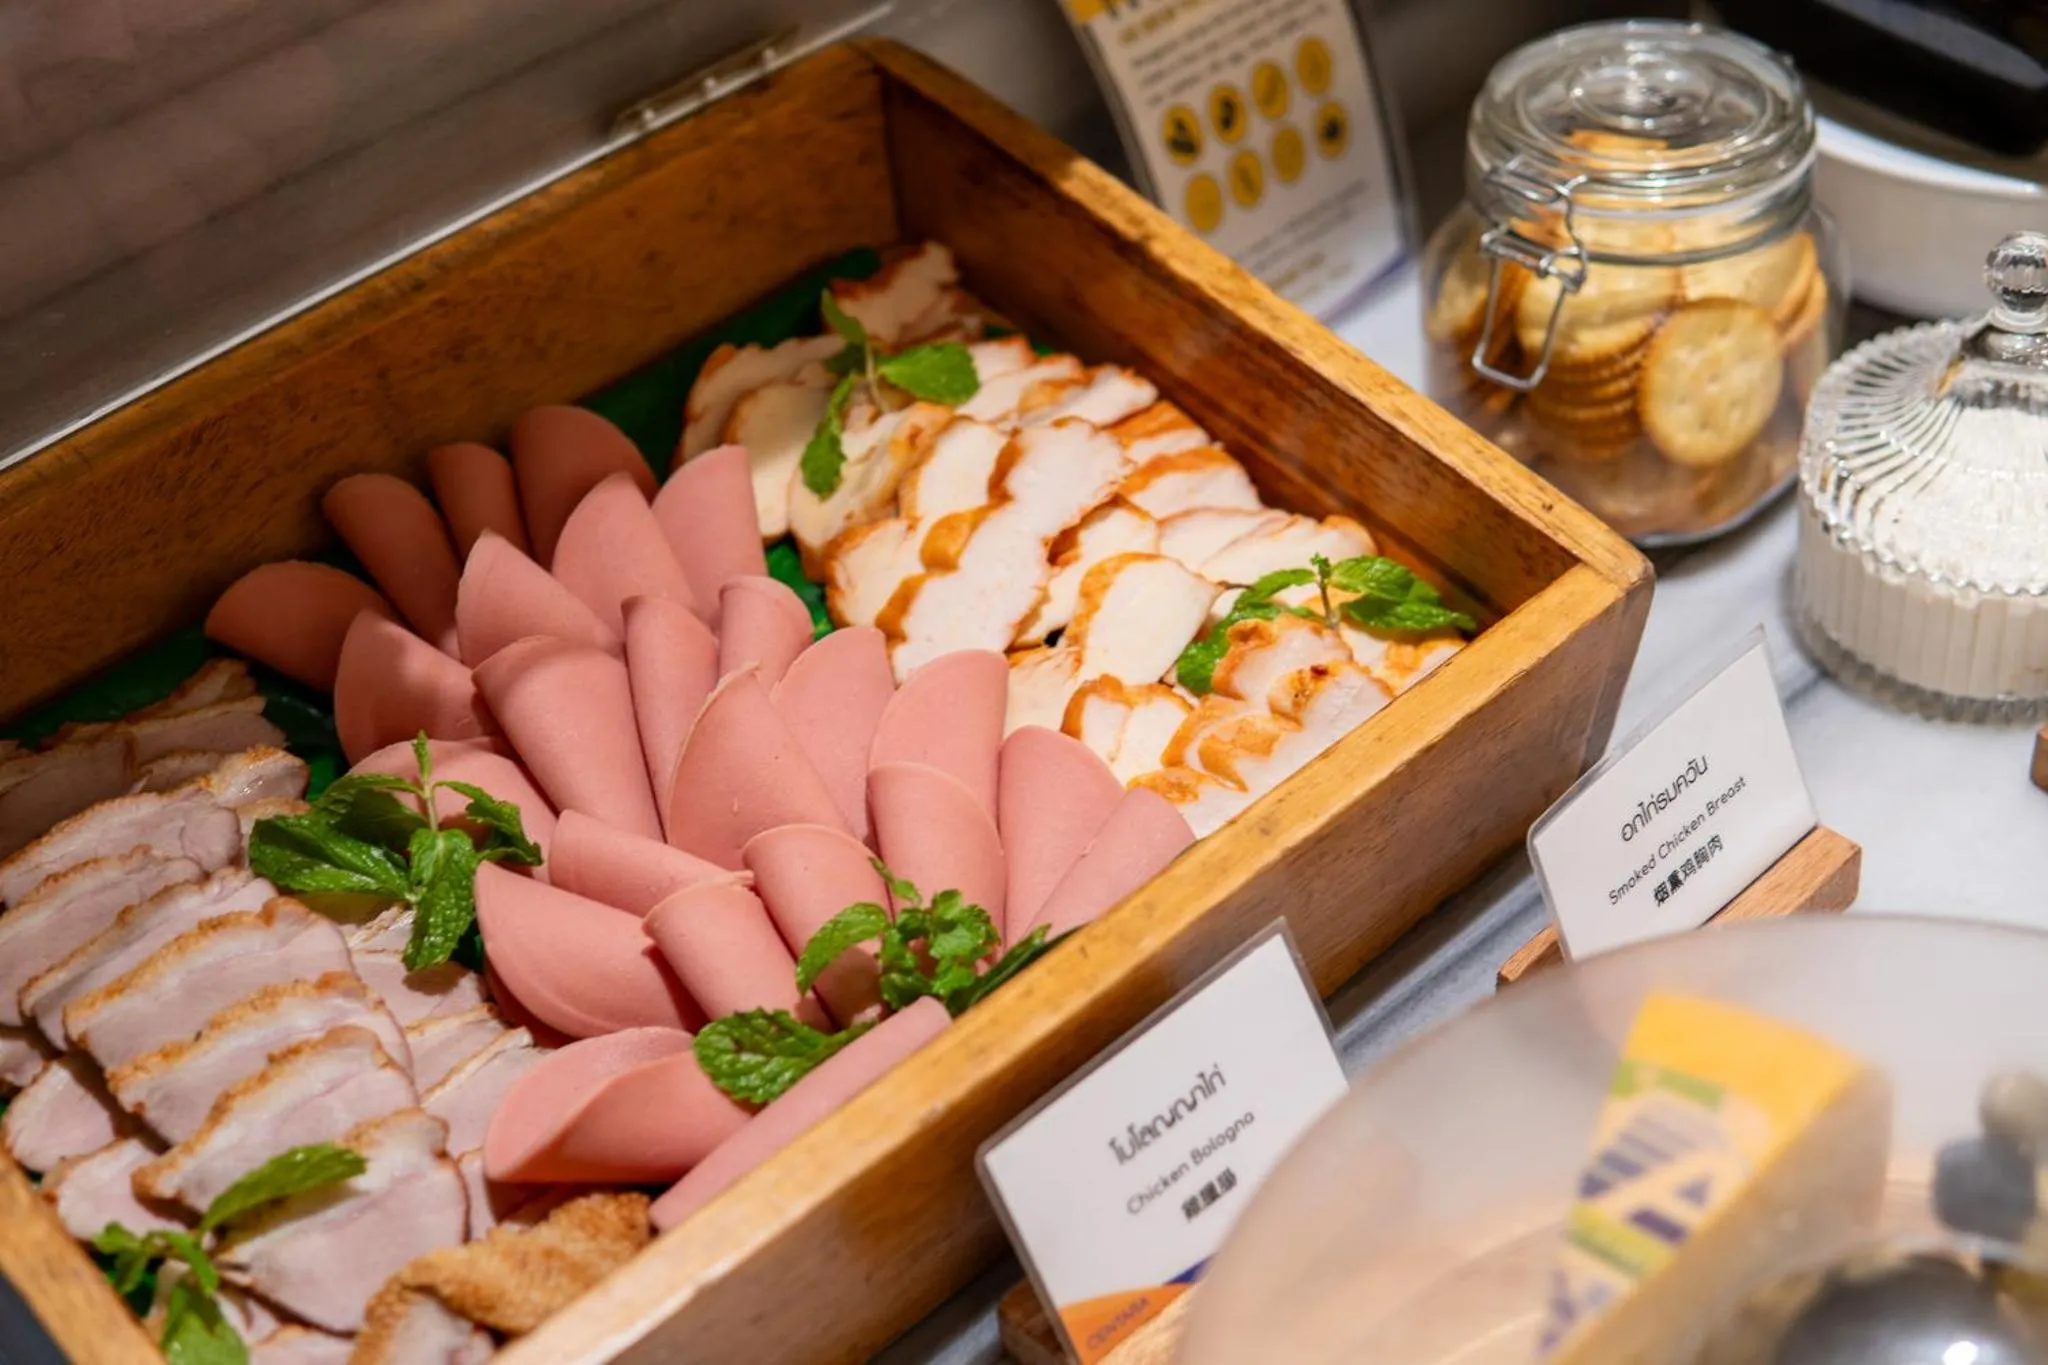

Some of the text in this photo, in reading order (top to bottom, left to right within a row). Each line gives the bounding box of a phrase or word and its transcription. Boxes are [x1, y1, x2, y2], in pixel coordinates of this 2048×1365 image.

[1608, 776, 1746, 905] Smoked Chicken Breast
[1126, 1154, 1190, 1216] Chicken
[1190, 1109, 1256, 1166] Bologna
